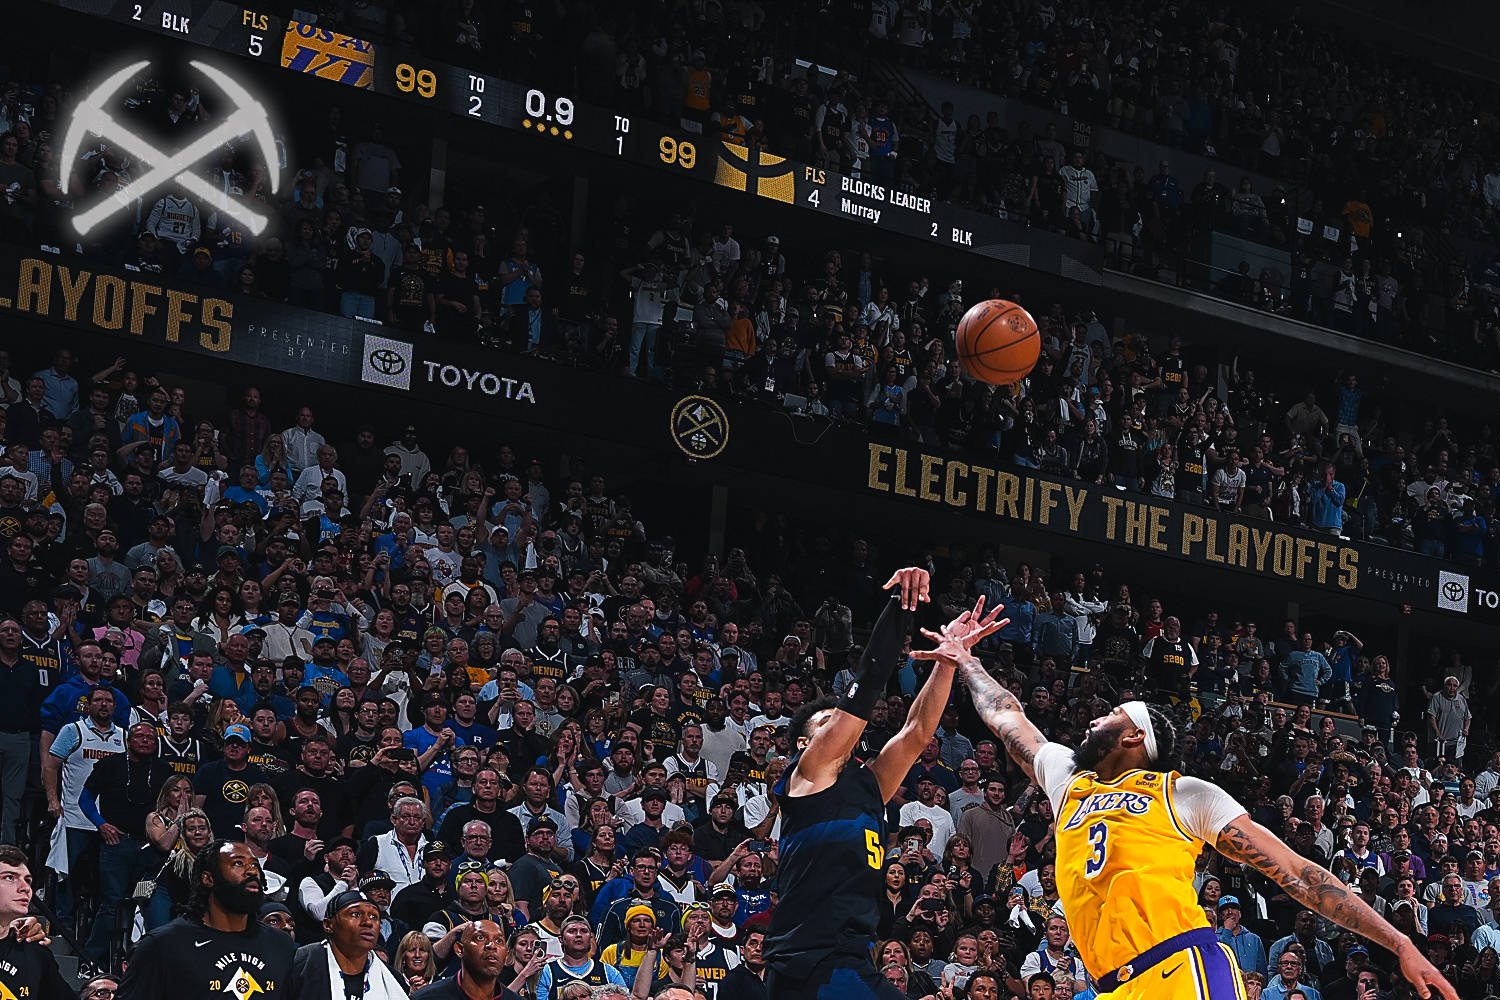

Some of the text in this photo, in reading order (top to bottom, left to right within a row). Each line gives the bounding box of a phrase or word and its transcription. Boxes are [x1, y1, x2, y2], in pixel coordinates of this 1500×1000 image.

[132, 4, 190, 34] 2 BLK
[243, 10, 269, 31] FLS
[249, 35, 263, 56] 5
[395, 63, 437, 98] 99
[468, 75, 485, 93] TO
[468, 96, 482, 117] 2
[525, 89, 575, 126] 0.9
[614, 115, 630, 133] TO
[616, 136, 623, 155] 1
[659, 136, 696, 169] 99
[804, 166, 827, 184] FLS
[807, 189, 820, 208] 4
[841, 177, 931, 214] BLOCKS LEADER
[841, 198, 881, 223] Murray
[173, 222, 186, 233] 27
[930, 222, 973, 246] 2 BLK
[0, 257, 234, 351] AYOFFS
[423, 360, 536, 404] TOYOTA
[868, 442, 1359, 591] ELECTRIFY THE PLAYOFFS
[1367, 566, 1430, 588] PRESENTED
[1174, 644, 1183, 652] 15
[533, 664, 564, 678] DENVER
[1163, 655, 1184, 667] 5280
[1062, 791, 1156, 832] LAKERS
[1084, 821, 1109, 879] 3
[215, 952, 266, 971] MILE HIGH
[20, 986, 30, 997] 24
[209, 980, 275, 991] 20 24
